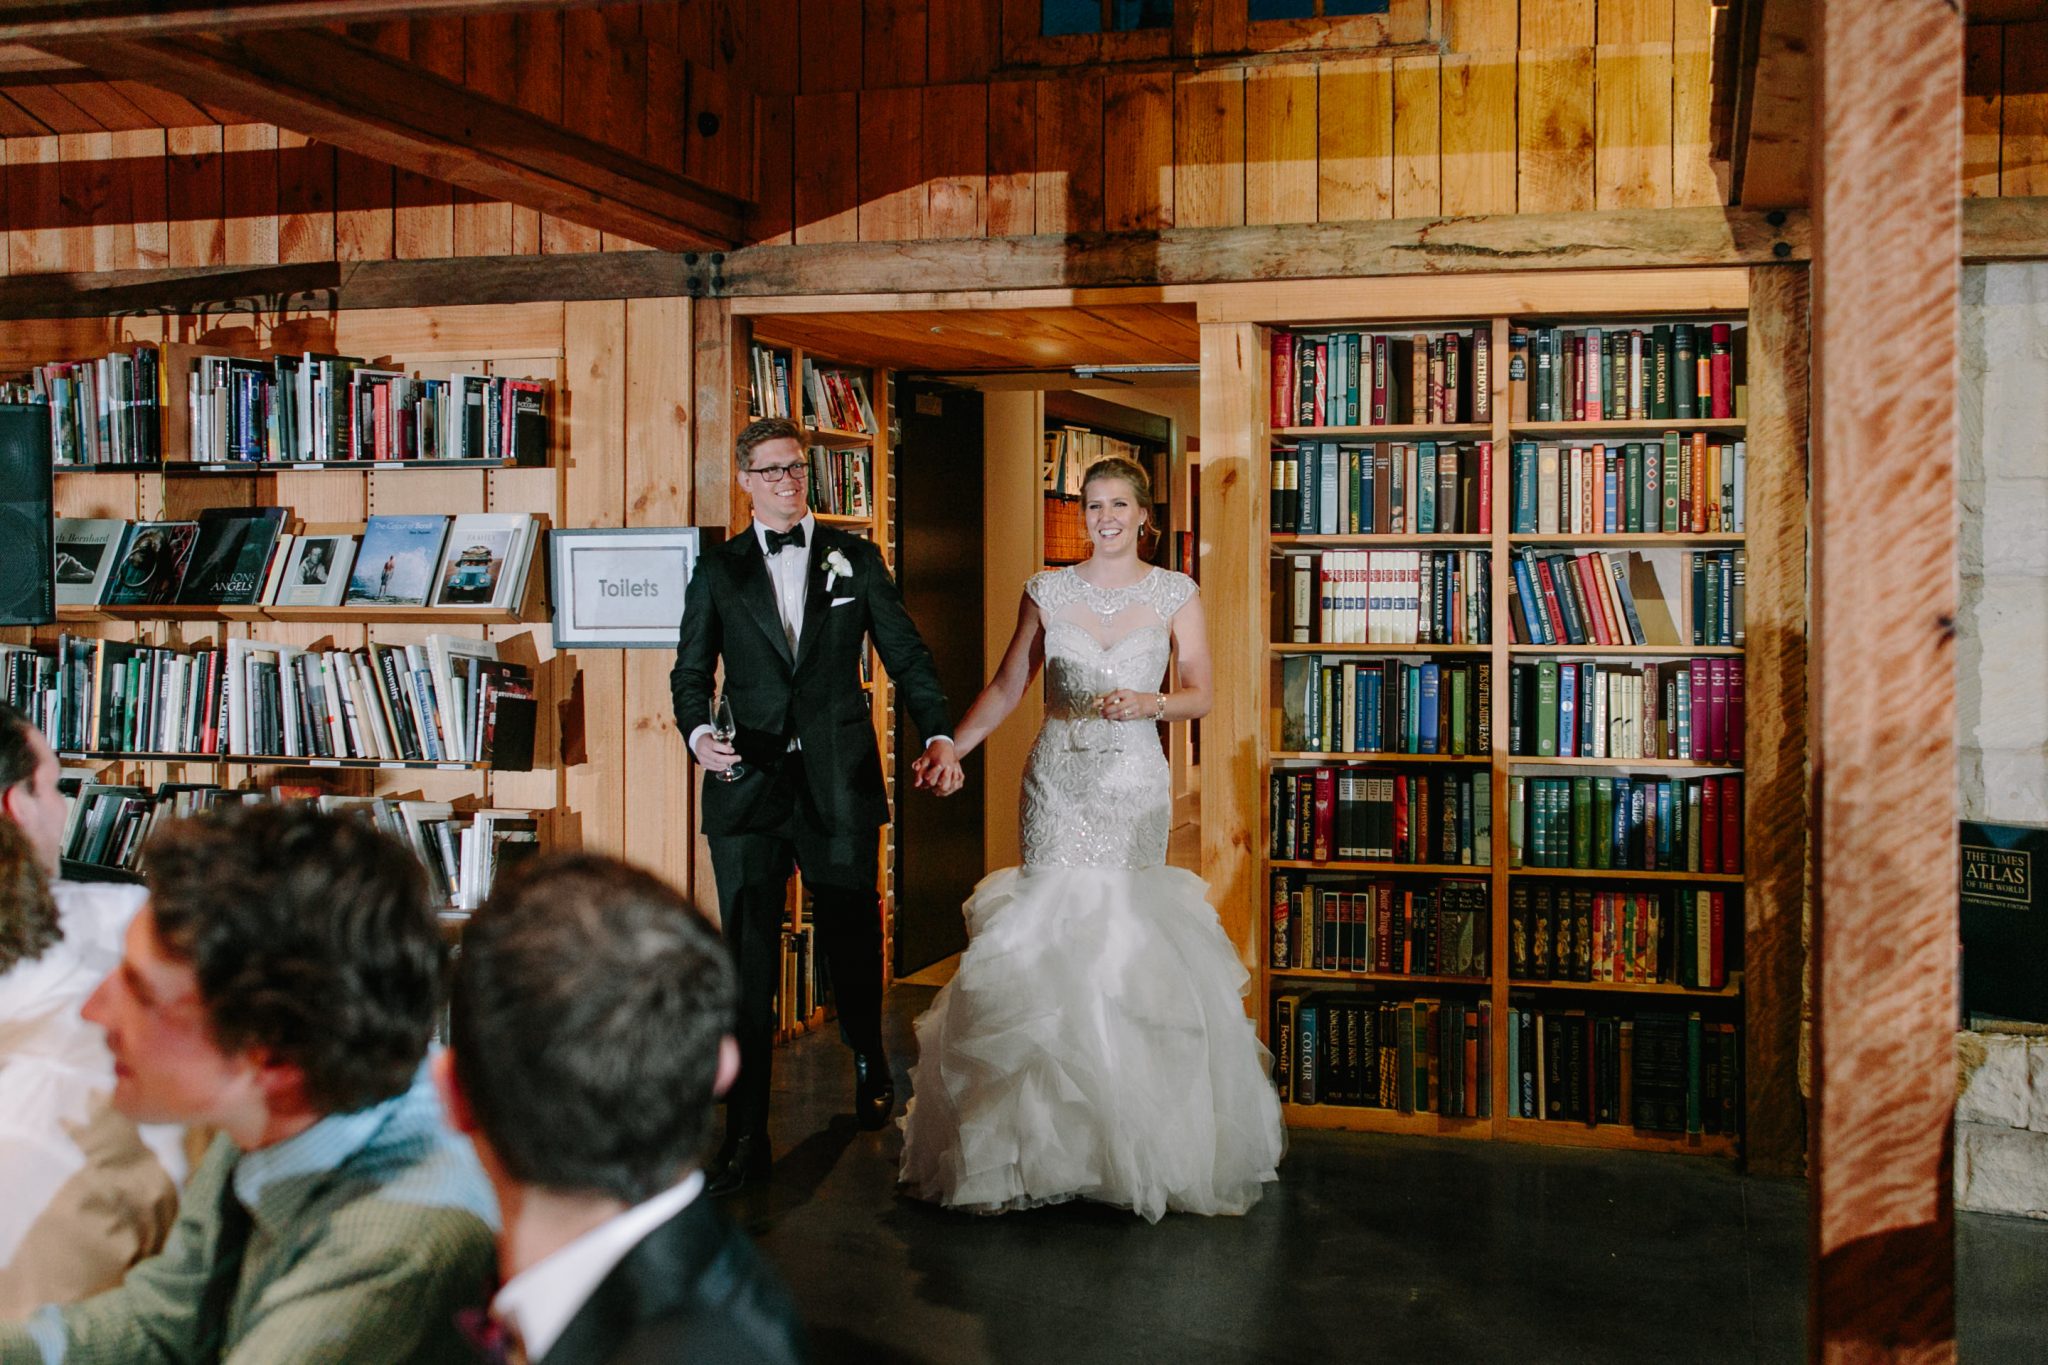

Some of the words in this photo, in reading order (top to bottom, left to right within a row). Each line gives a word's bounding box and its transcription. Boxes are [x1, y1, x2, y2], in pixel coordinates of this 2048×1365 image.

[1656, 344, 1665, 371] JULIUS
[1477, 345, 1487, 406] BEETHOVEN
[1656, 372, 1665, 404] CAESAR
[1665, 457, 1677, 485] LIFE
[1304, 487, 1312, 497] AND
[68, 533, 110, 543] Bernhard
[466, 534, 496, 542] FAMILY
[210, 582, 253, 592] ANGELS
[598, 578, 659, 598] Toilets
[1544, 624, 1552, 640] FOLIO
[382, 655, 399, 700] Souvenirs
[1479, 664, 1489, 682] EPICS
[1479, 692, 1489, 704] THE
[1479, 705, 1489, 730] MIDDLE
[1479, 731, 1489, 751] AGES
[1965, 851, 1987, 862] THE
[1990, 853, 2024, 867] TIMES
[1966, 863, 2024, 884] ATLAS
[1966, 880, 1976, 888] OF
[1979, 882, 1994, 890] THE
[1996, 883, 2025, 894] WORLD
[1380, 889, 1390, 910] Doctor
[1378, 911, 1390, 936] Zhivago
[1280, 1023, 1290, 1073] Beowulf
[1302, 1031, 1312, 1080] COLOUR
